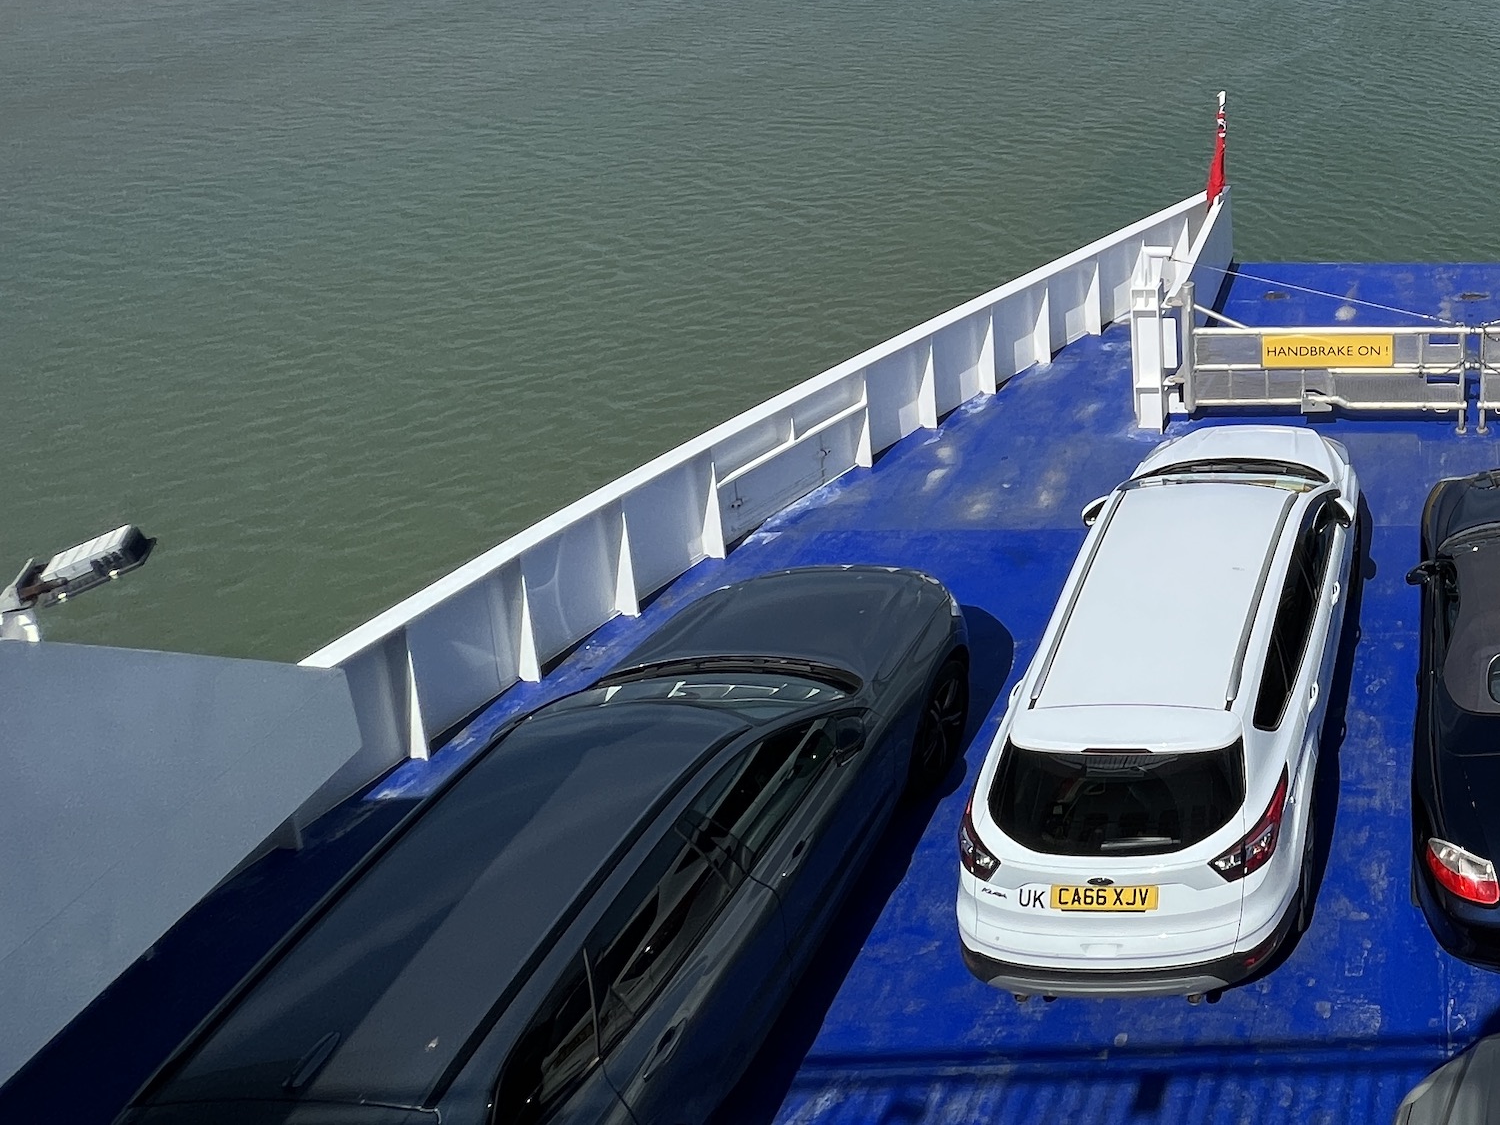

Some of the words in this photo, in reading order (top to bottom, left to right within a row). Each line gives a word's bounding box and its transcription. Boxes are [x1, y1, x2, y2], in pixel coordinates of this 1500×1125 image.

[1266, 346, 1354, 357] HANDBRAKE
[1357, 346, 1381, 356] ON
[1018, 888, 1046, 909] UK
[1058, 888, 1107, 906] CA66
[1112, 888, 1149, 906] XJV
